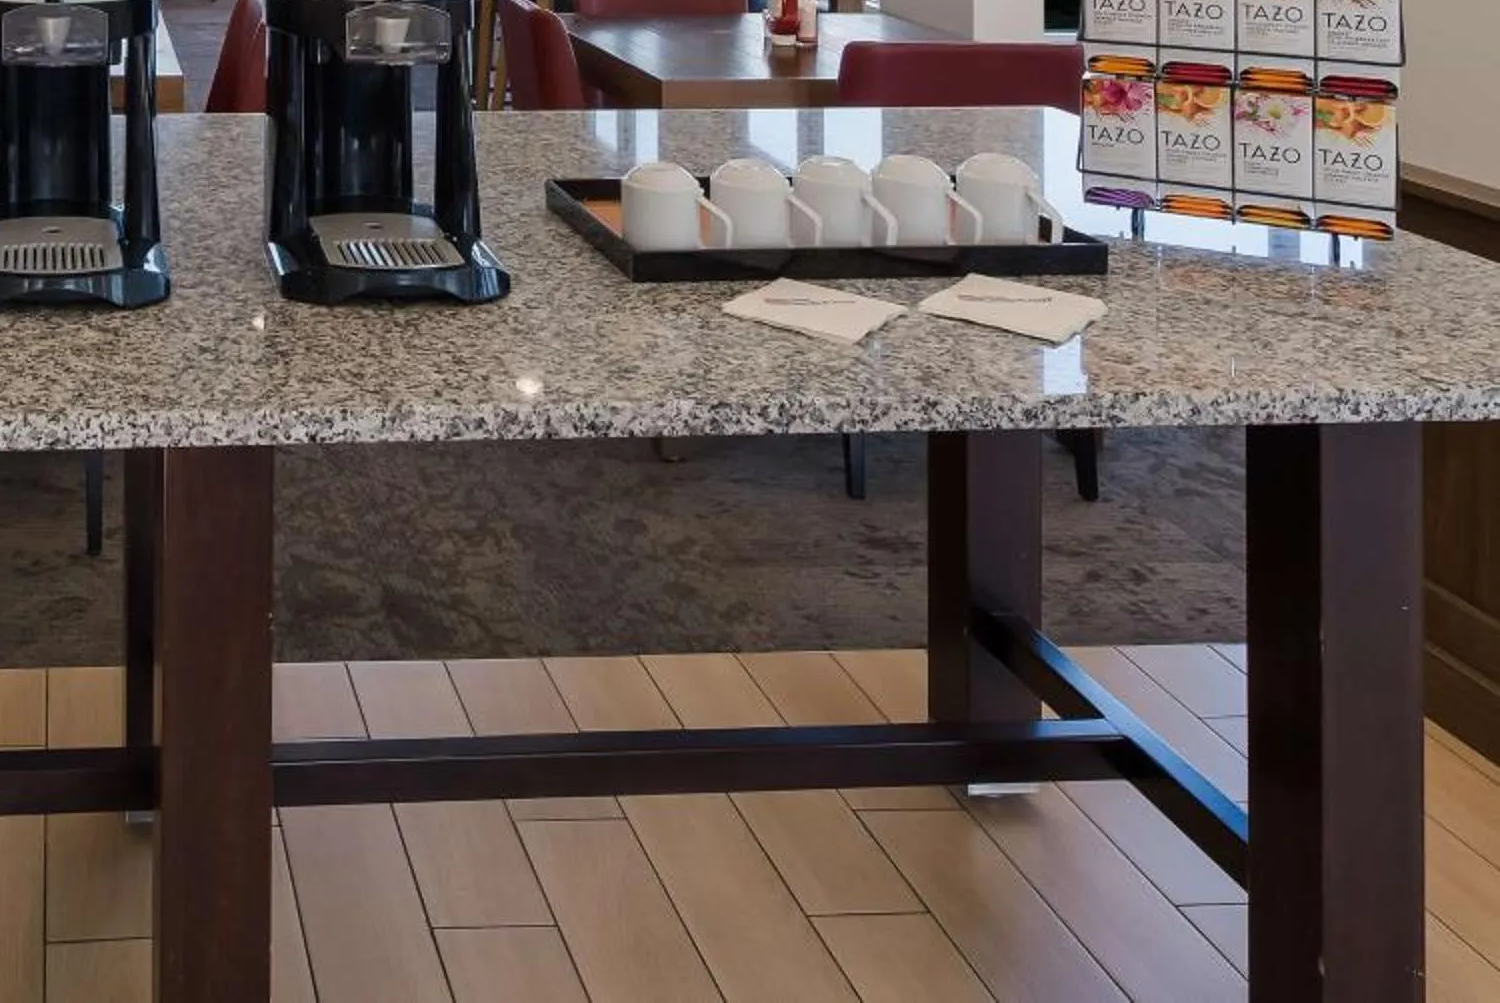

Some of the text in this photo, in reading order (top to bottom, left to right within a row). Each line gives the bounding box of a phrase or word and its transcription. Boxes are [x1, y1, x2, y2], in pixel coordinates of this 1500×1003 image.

[1163, 0, 1224, 20] TAZO
[1243, 3, 1304, 23] TAZO
[1321, 12, 1388, 32] TAZO
[1087, 124, 1145, 145] TAZO
[1161, 130, 1221, 151] TAZO
[1238, 142, 1301, 164] TAZO
[1317, 148, 1383, 172] TAZO
